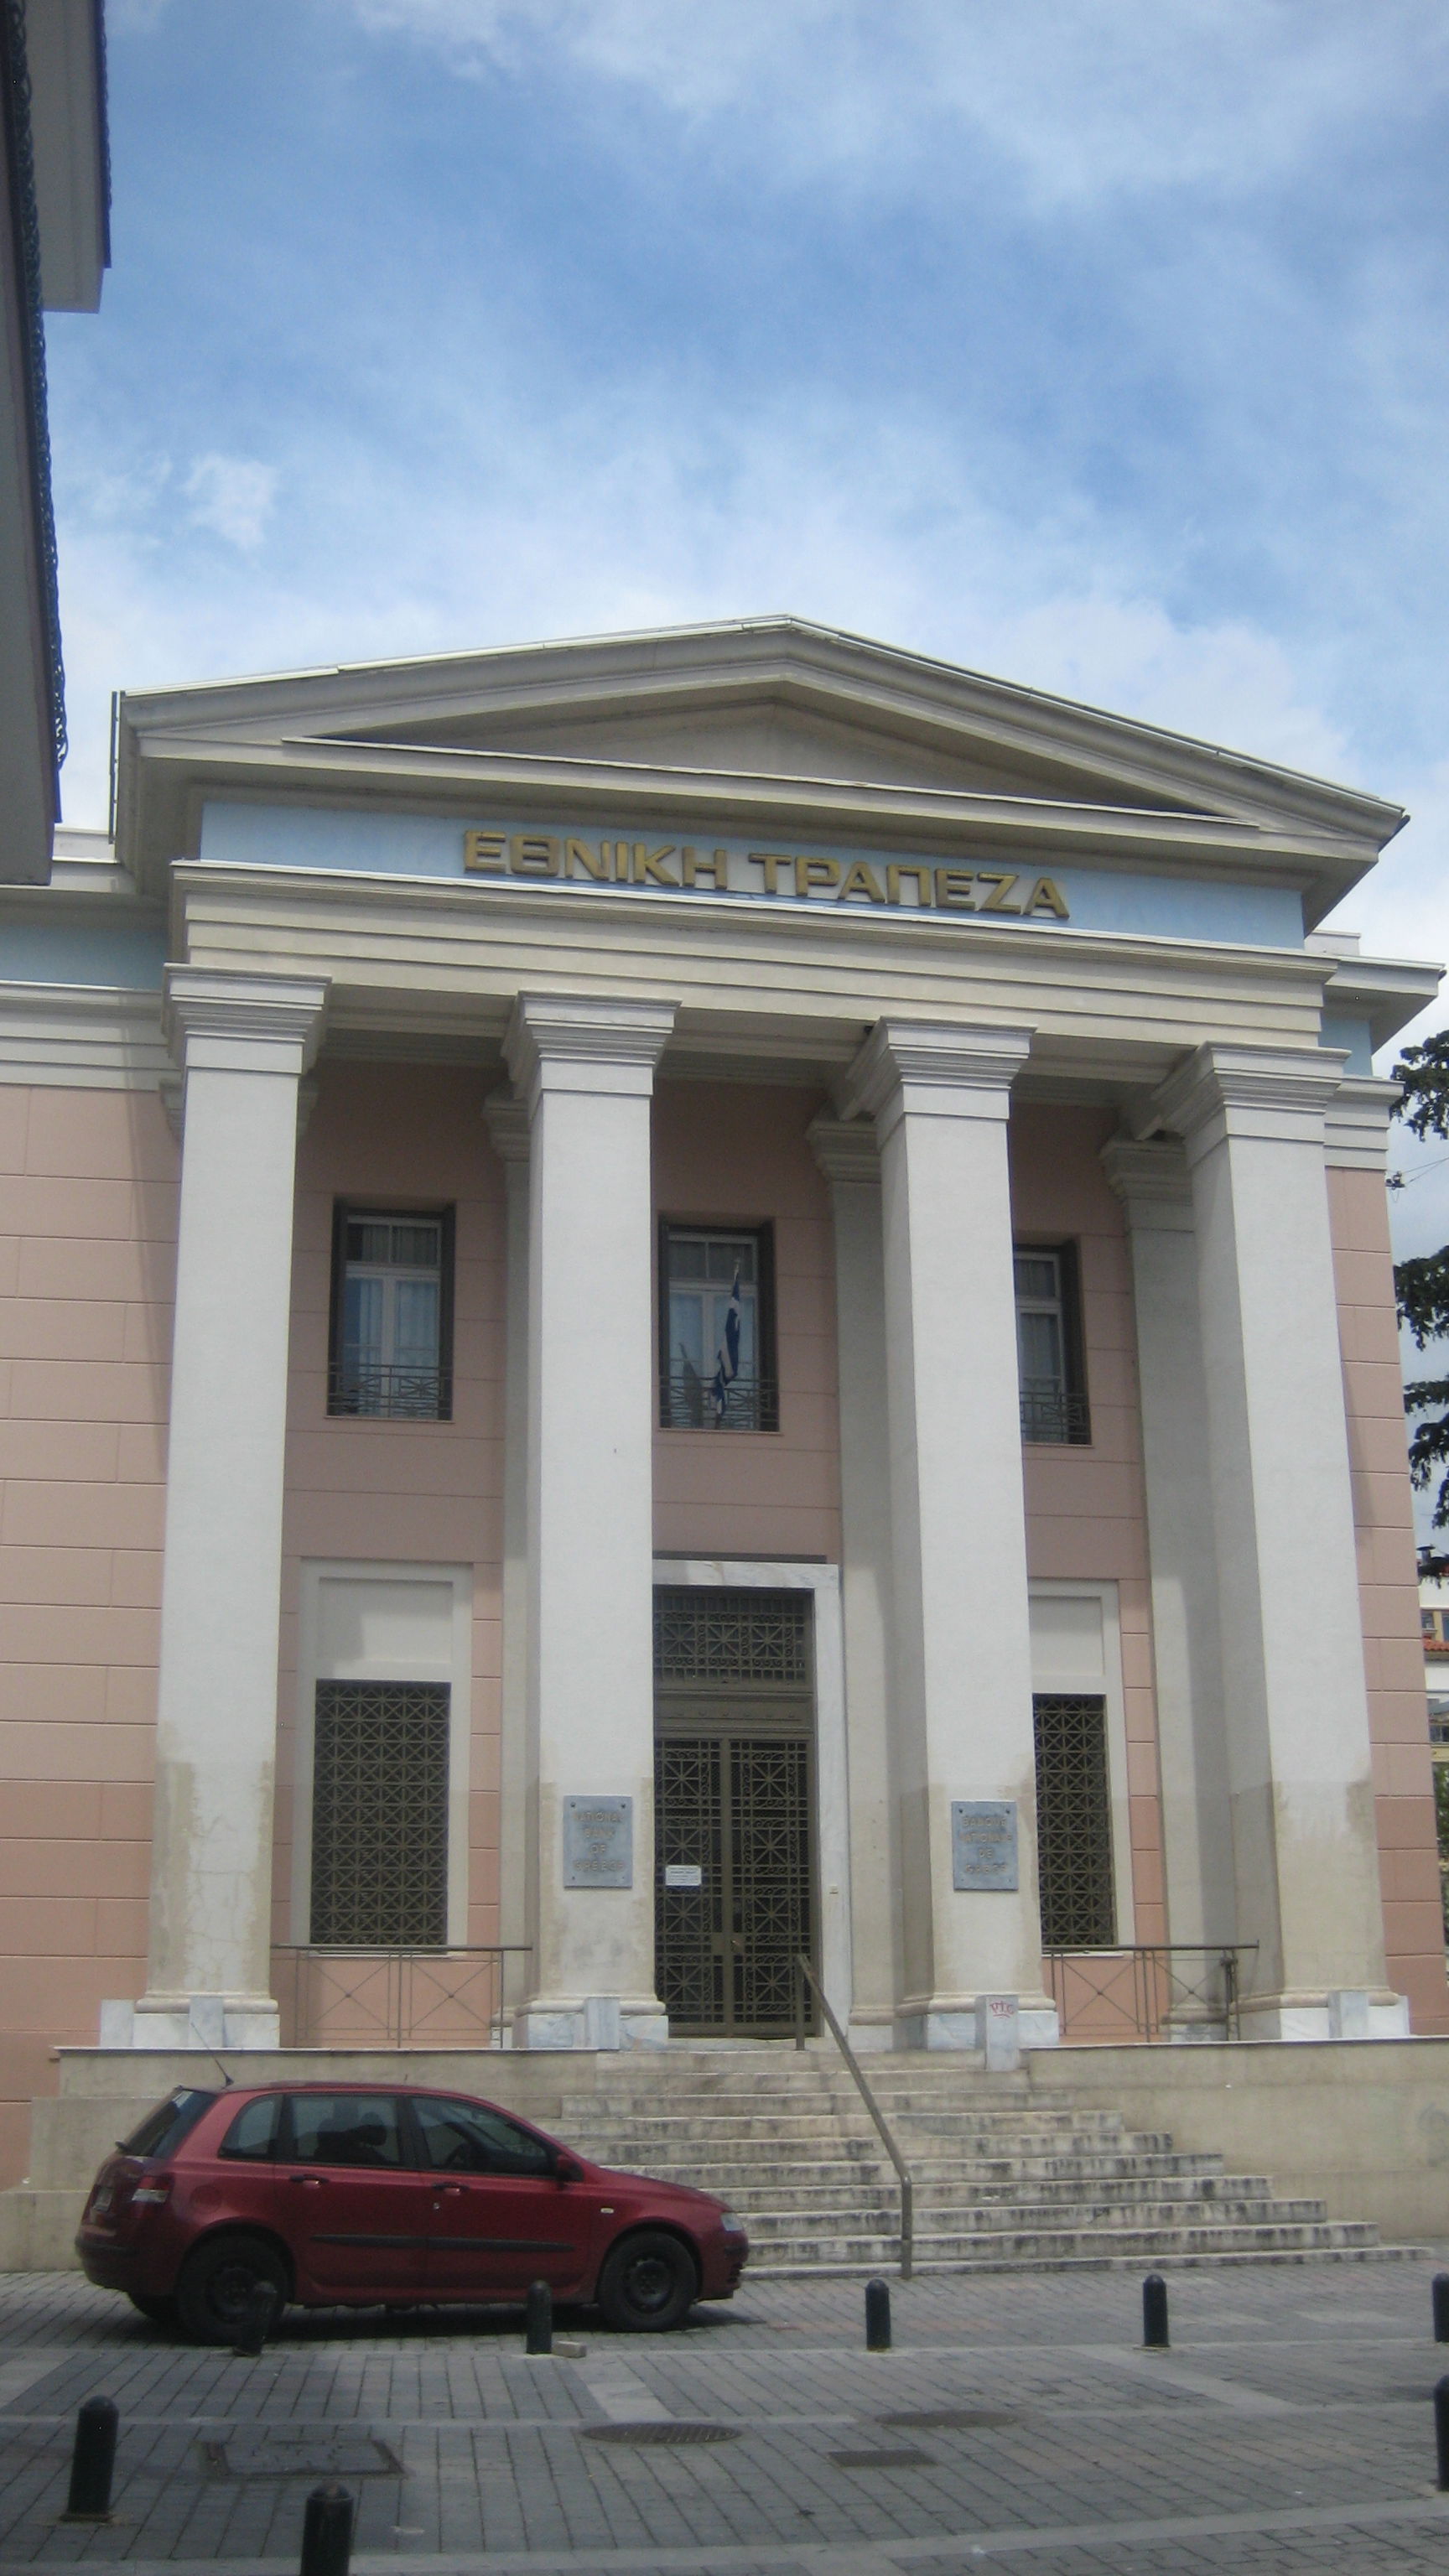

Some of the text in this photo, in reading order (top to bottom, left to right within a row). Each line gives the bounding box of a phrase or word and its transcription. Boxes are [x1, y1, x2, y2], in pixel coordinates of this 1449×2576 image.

[463, 829, 1071, 919] ΕΘΝΙΚΗ ΤΡΑΠΕΖΑ
[589, 1843, 607, 1854] OF
[978, 1847, 994, 1858] DE
